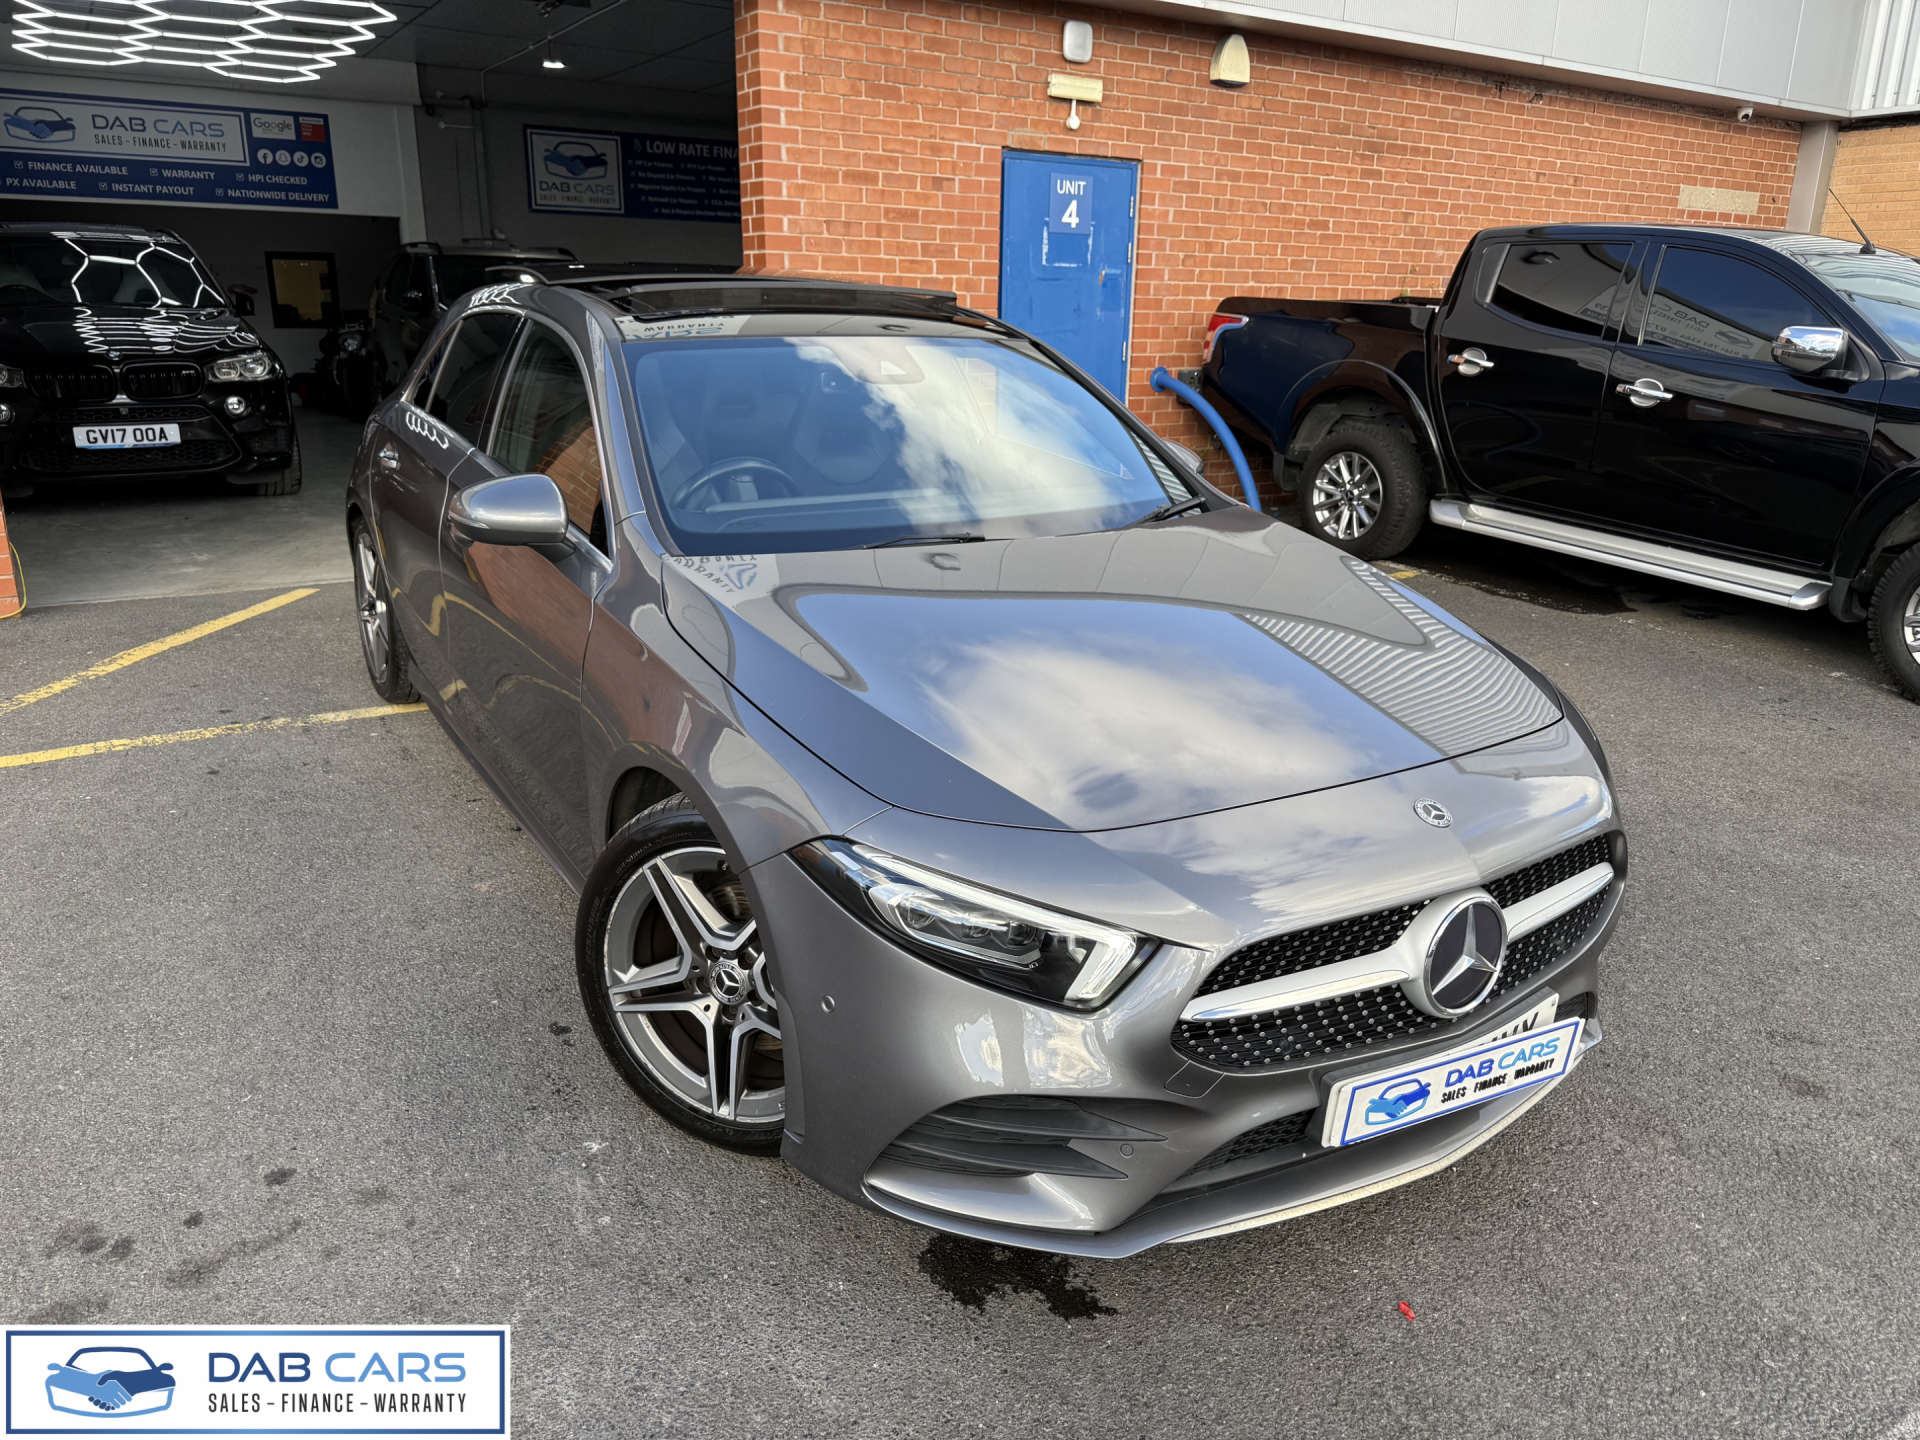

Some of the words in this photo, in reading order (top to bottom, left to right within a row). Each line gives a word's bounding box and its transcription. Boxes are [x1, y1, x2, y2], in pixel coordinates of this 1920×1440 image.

[91, 114, 146, 132] DAB
[153, 119, 225, 138] CARS
[253, 117, 293, 132] Google
[94, 134, 122, 146] SALES
[133, 136, 170, 149] FINANCE
[180, 139, 226, 153] WARRANTY
[646, 139, 675, 155] LOW
[679, 142, 711, 158] RATE
[27, 161, 73, 172] FINANCE
[75, 163, 129, 175] AVAILABLE
[162, 169, 215, 180] WARRANTY
[5, 177, 20, 187] PX
[22, 178, 77, 190] AVAILABLE
[248, 174, 264, 183] HPI
[266, 175, 308, 185] CHECKED
[112, 183, 153, 193] INSTANT
[156, 185, 195, 195] PAYOUT
[539, 181, 571, 193] DAB
[574, 182, 615, 196] CARS
[1056, 179, 1087, 196] UNIT
[227, 188, 287, 200] NATIONWIDE
[288, 191, 329, 203] DELIVERY
[1061, 199, 1080, 229] 4
[85, 428, 127, 444] GV17
[1445, 1058, 1495, 1087] DAB
[1497, 1037, 1560, 1070] CARS
[1441, 1086, 1467, 1103] SALES
[1474, 1073, 1508, 1093] FINANCE
[1514, 1058, 1555, 1080] WARRANTY
